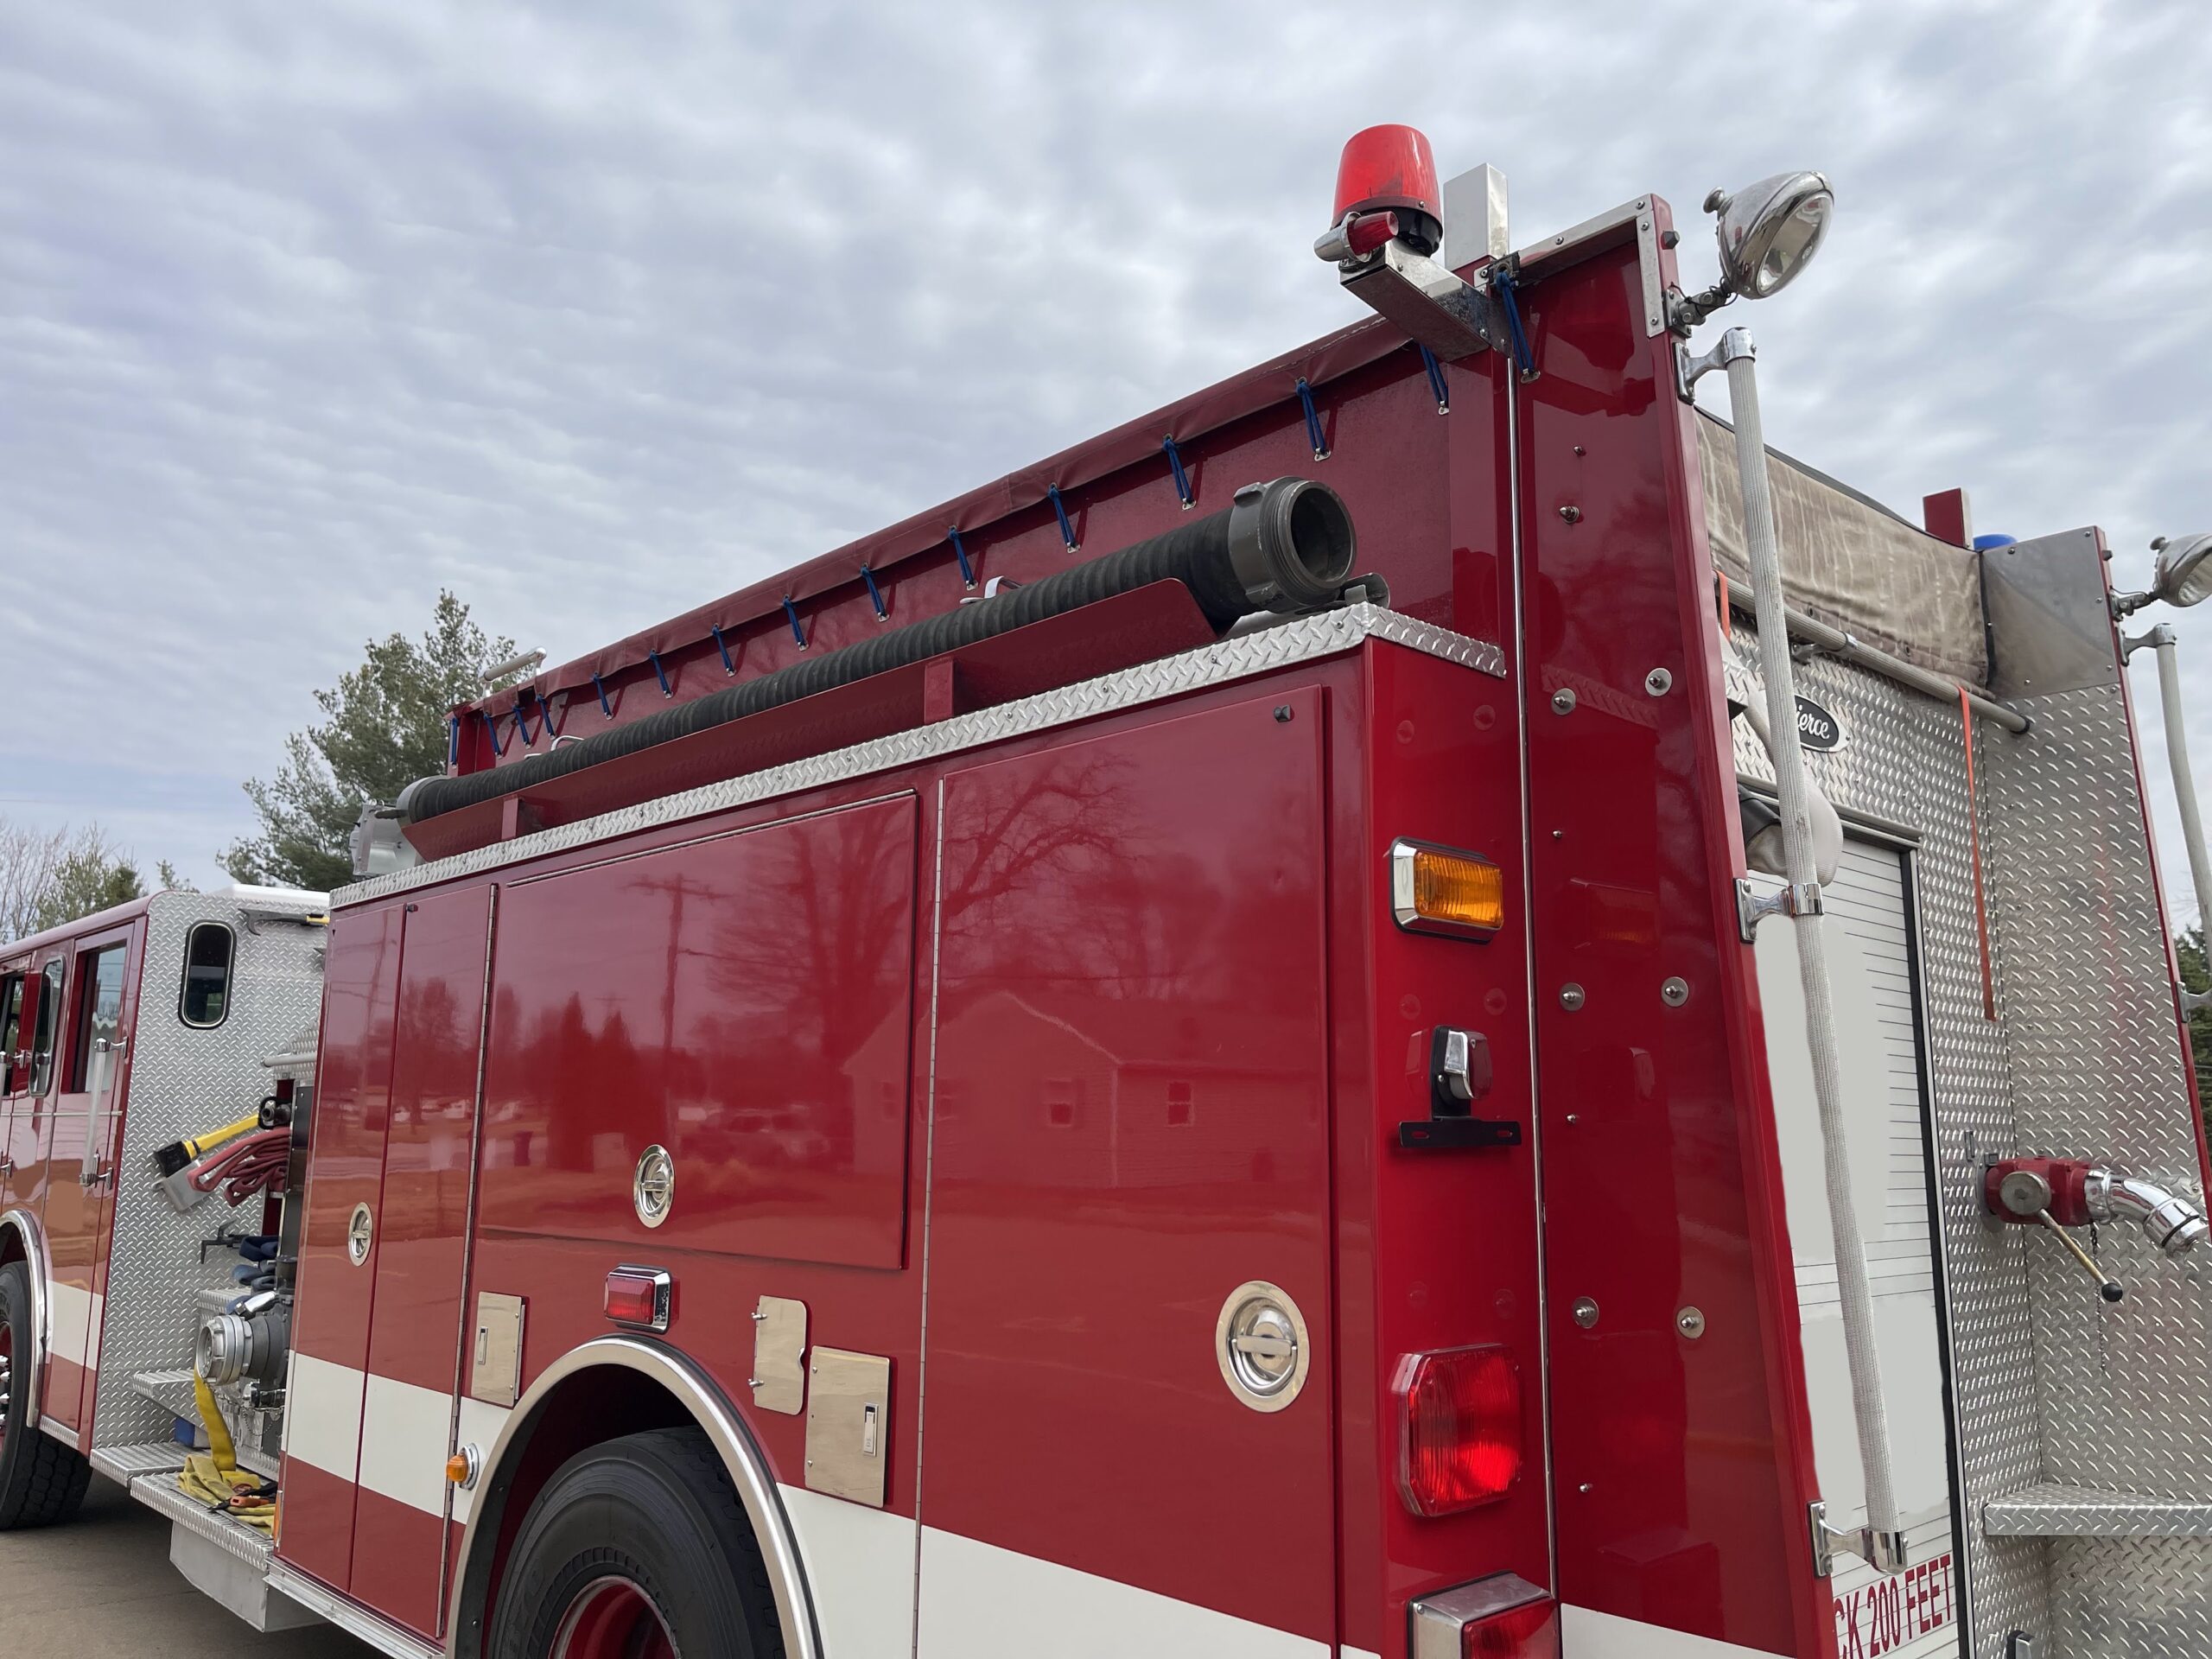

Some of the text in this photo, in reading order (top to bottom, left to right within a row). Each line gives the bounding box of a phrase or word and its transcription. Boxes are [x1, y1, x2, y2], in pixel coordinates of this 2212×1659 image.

[1796, 704, 1830, 740] ierce
[1834, 1554, 1951, 1659] CK 200 FEET
